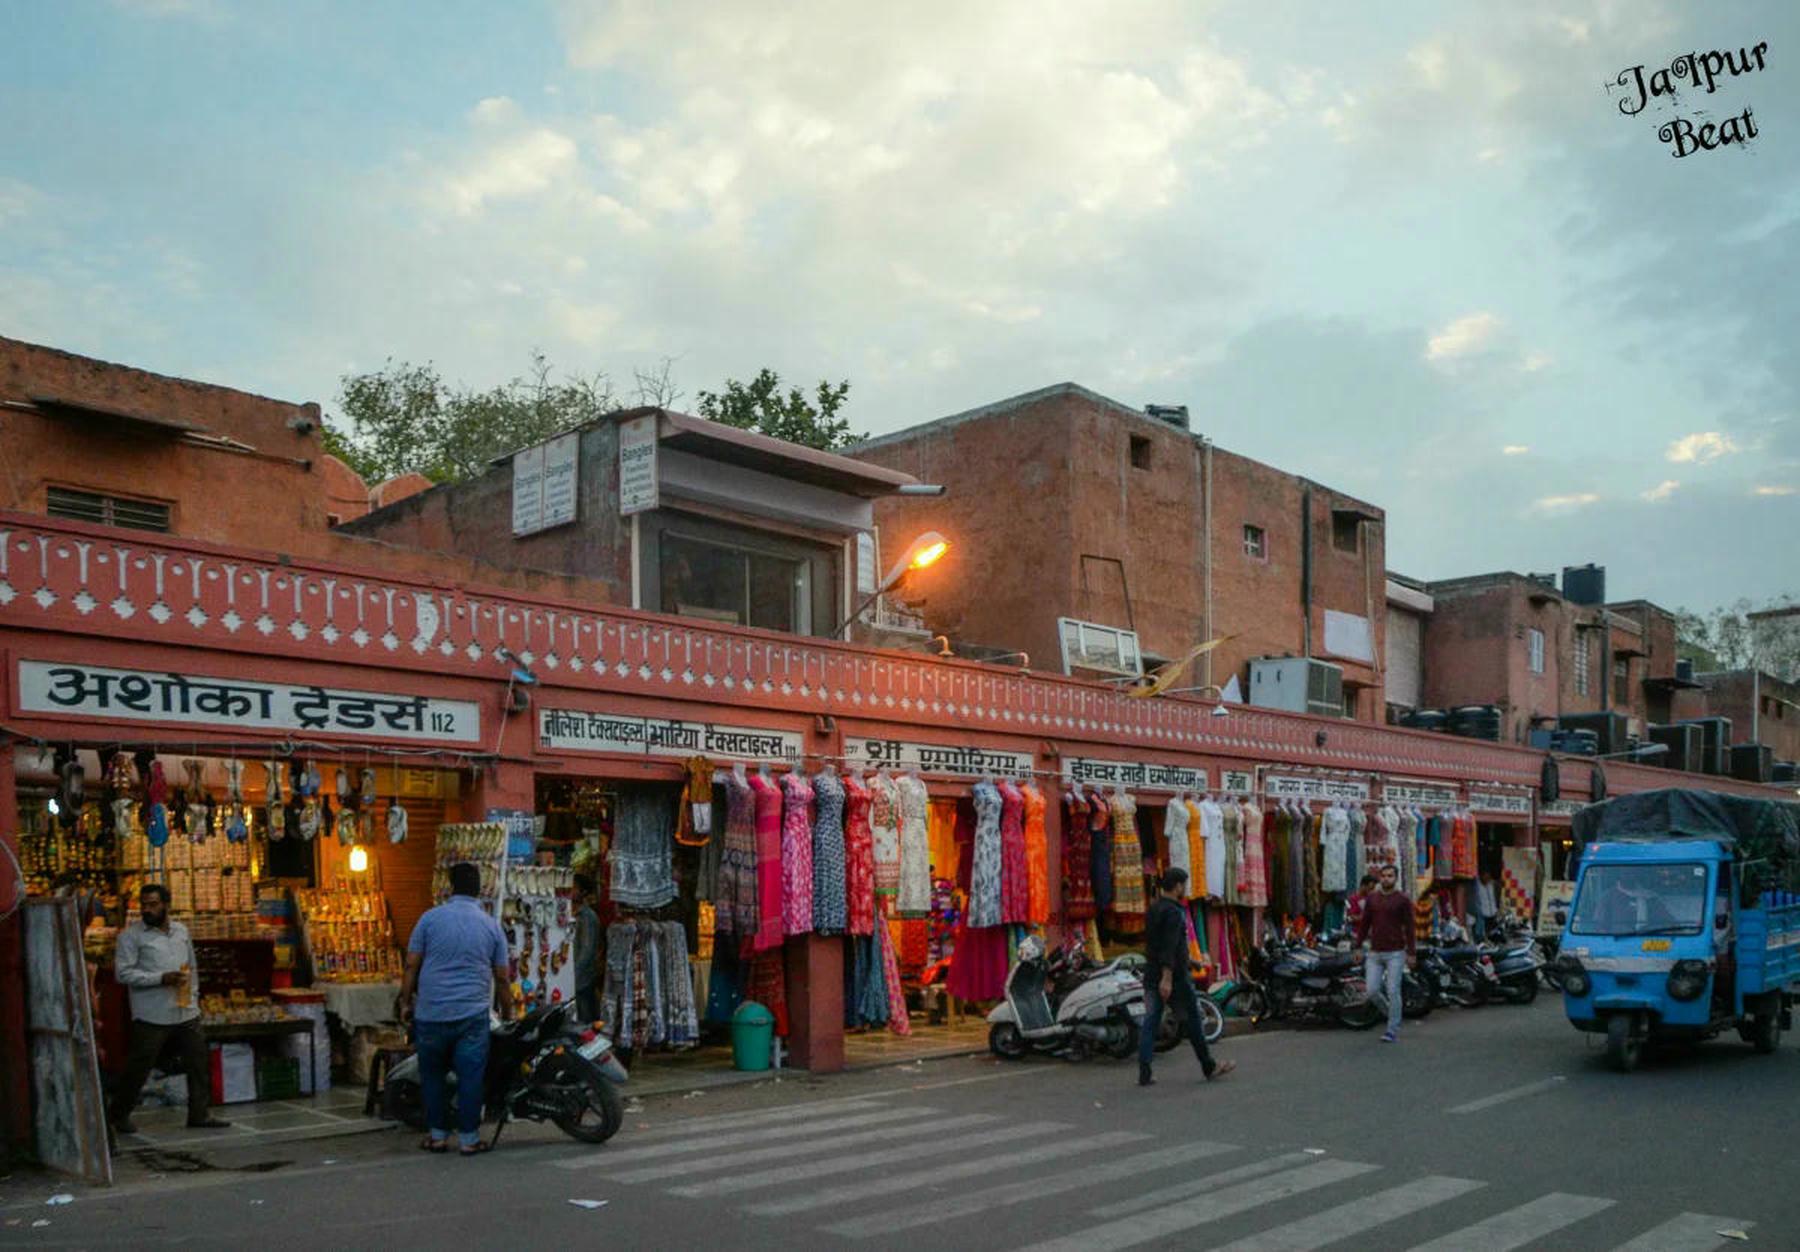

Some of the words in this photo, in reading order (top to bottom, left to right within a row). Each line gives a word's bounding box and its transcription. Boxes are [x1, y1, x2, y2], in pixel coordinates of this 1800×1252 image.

[47, 668, 272, 719] अशोका
[290, 686, 428, 732] ट्रेडर्स
[431, 712, 455, 733] 112
[649, 719, 700, 749] भाटिया
[865, 740, 903, 769] श्री
